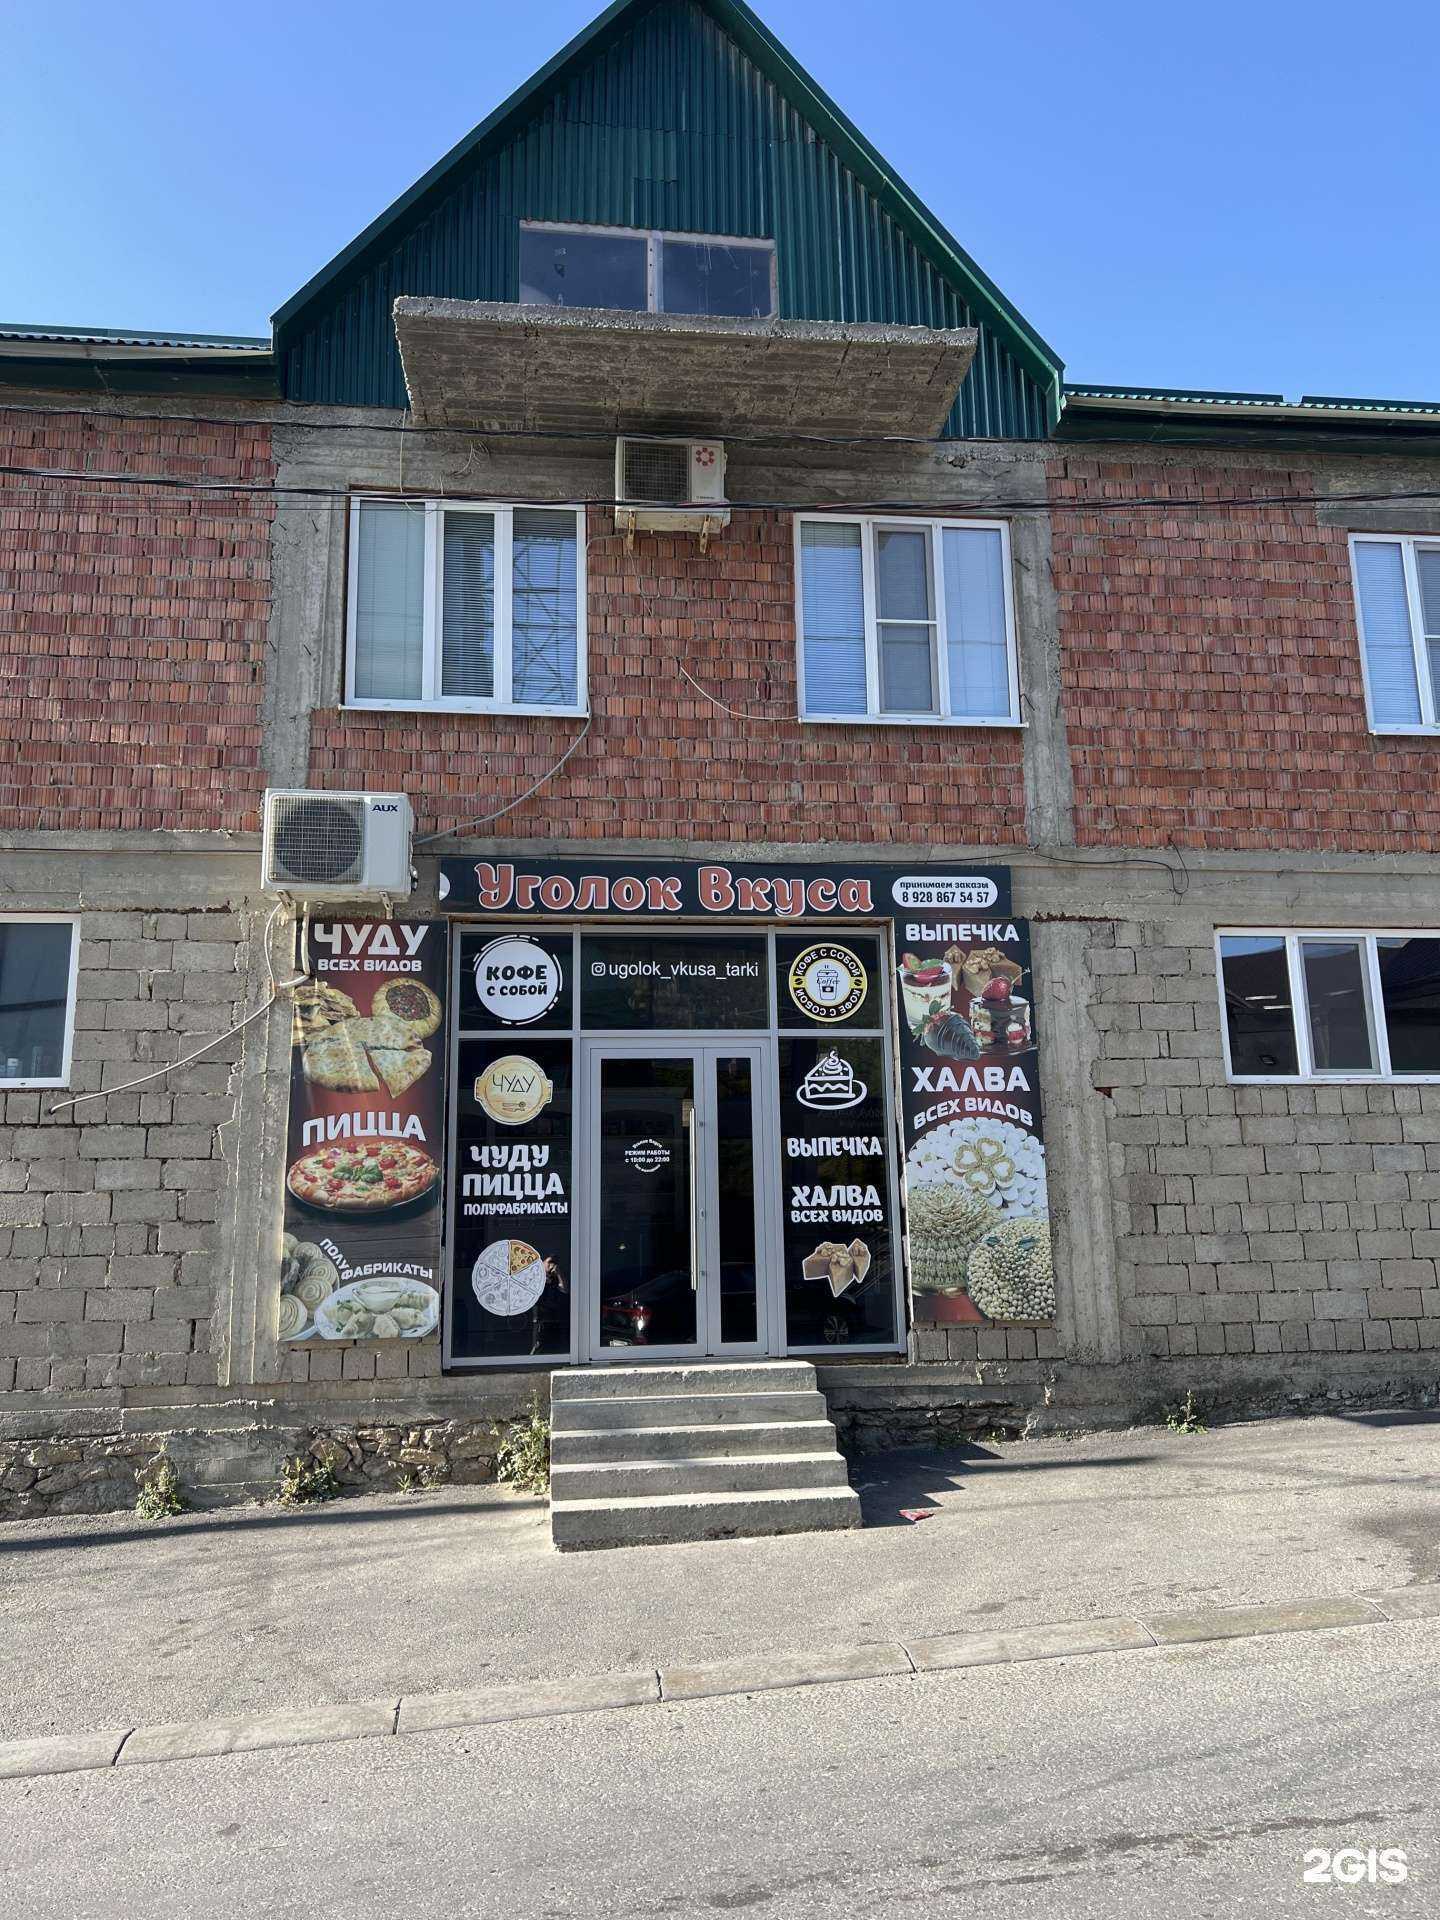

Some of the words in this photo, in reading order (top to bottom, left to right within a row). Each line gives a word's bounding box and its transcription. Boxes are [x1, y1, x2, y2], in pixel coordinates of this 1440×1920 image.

[371, 804, 398, 812] AUX
[474, 863, 682, 911] Уголок
[698, 866, 874, 917] Вкуса
[900, 880, 953, 891] принимаем
[955, 881, 989, 889] заказы
[902, 892, 909, 903] 8
[912, 891, 933, 903] 928
[936, 891, 957, 903] 867
[960, 891, 973, 903] 54
[977, 891, 989, 903] 57
[314, 923, 429, 955] ЧУДУ
[905, 923, 1020, 942] ВЫПЕЧКА
[317, 958, 360, 971] ВСЕХ
[363, 959, 422, 972] ВИДОВ
[486, 964, 547, 981] КОФЕ
[608, 962, 758, 980] ugolok_vkusa_tarki
[795, 951, 818, 976] КОФЕ
[820, 948, 827, 957] С
[829, 949, 860, 976] СОБОЙ
[499, 982, 548, 996] СОБОЙ
[795, 988, 827, 1016] СОБОЙ
[838, 989, 861, 1014] КОФЕ
[492, 1073, 535, 1093] ЧУДУ
[911, 1066, 1031, 1092] ХАЛВА
[913, 1098, 962, 1130] ВСЕХ
[964, 1097, 1033, 1127] ВИДОВ
[302, 1111, 427, 1147] ПИЦЦА
[786, 1136, 883, 1157] ВЫПЕЧКА
[470, 1144, 549, 1172] ЧУДУ
[462, 1172, 565, 1200] ПИЦЦА
[791, 1184, 881, 1207] ХАЛВА
[463, 1201, 568, 1216] ПОЛУФАБРИКАТЫ
[791, 1209, 829, 1223] ВСЕХ
[831, 1209, 884, 1225] ВИДОВ
[319, 1238, 433, 1280] ПОЛУФАБРИКАТЫ
